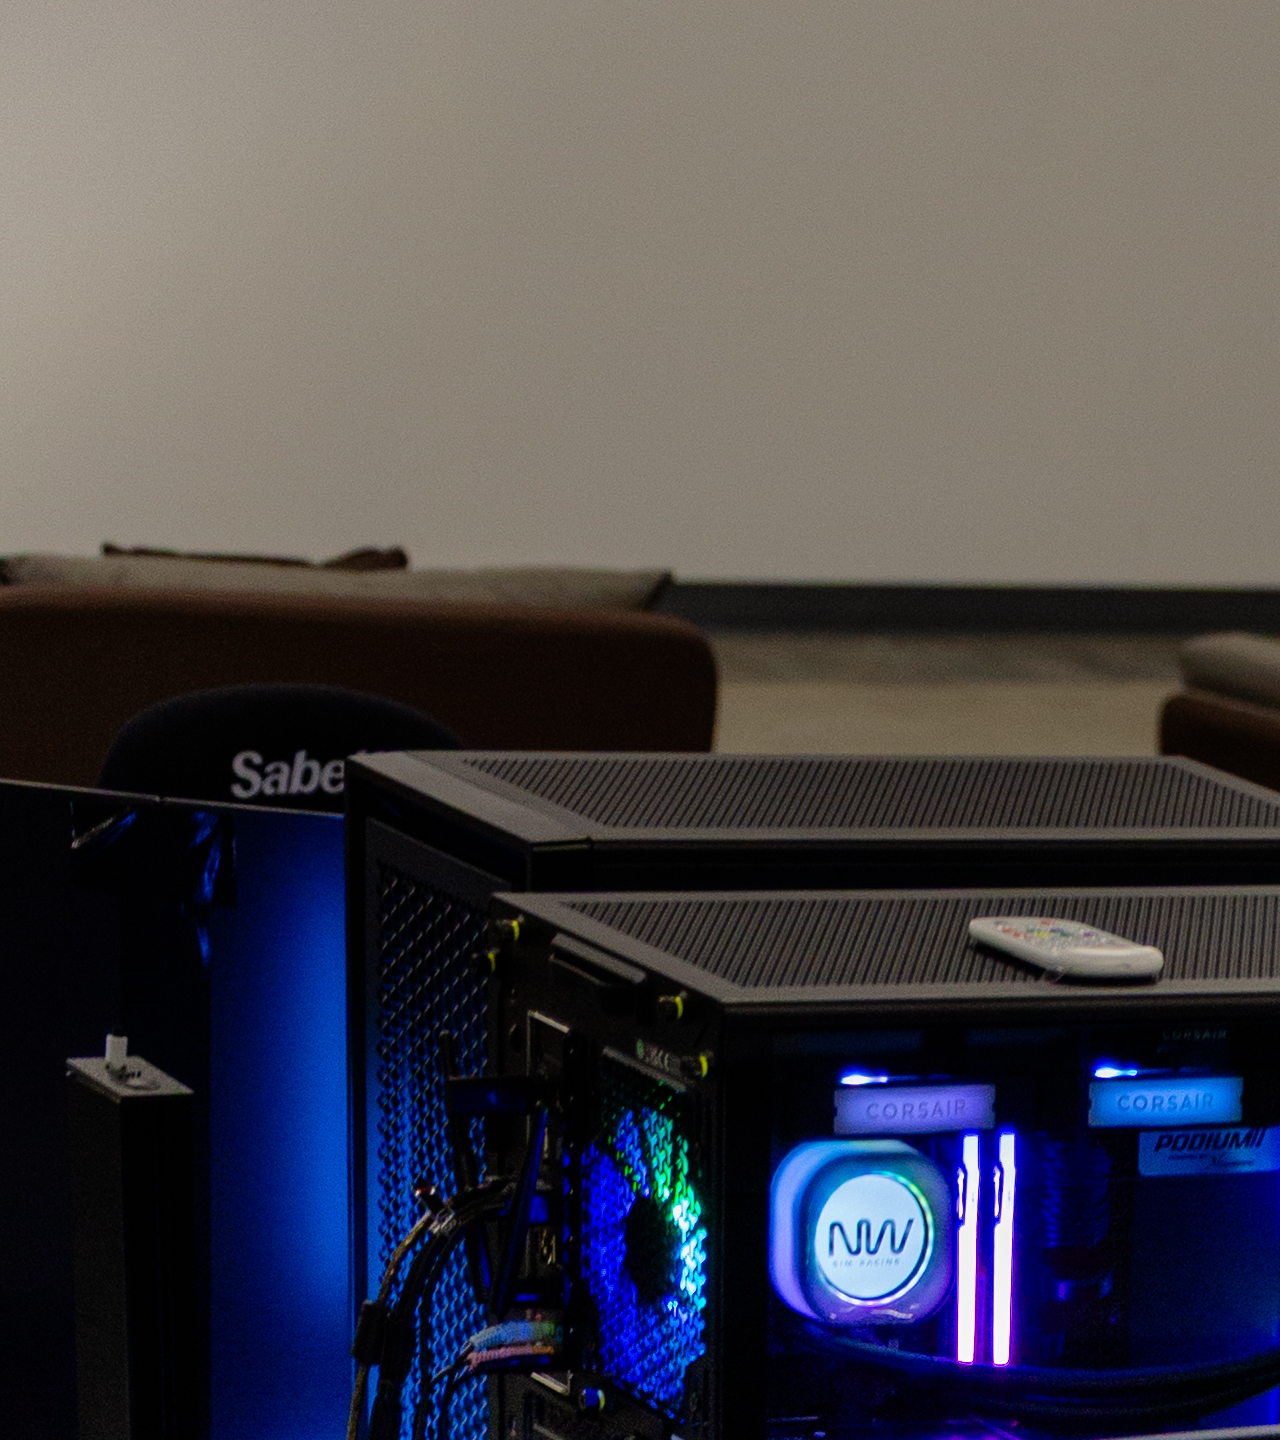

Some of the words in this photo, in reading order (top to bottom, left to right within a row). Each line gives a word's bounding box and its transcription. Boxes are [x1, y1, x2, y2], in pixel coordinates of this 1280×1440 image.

[230, 750, 345, 799] Sabe
[865, 1099, 967, 1122] CORSAIR
[1117, 1092, 1215, 1113] CORSAIR
